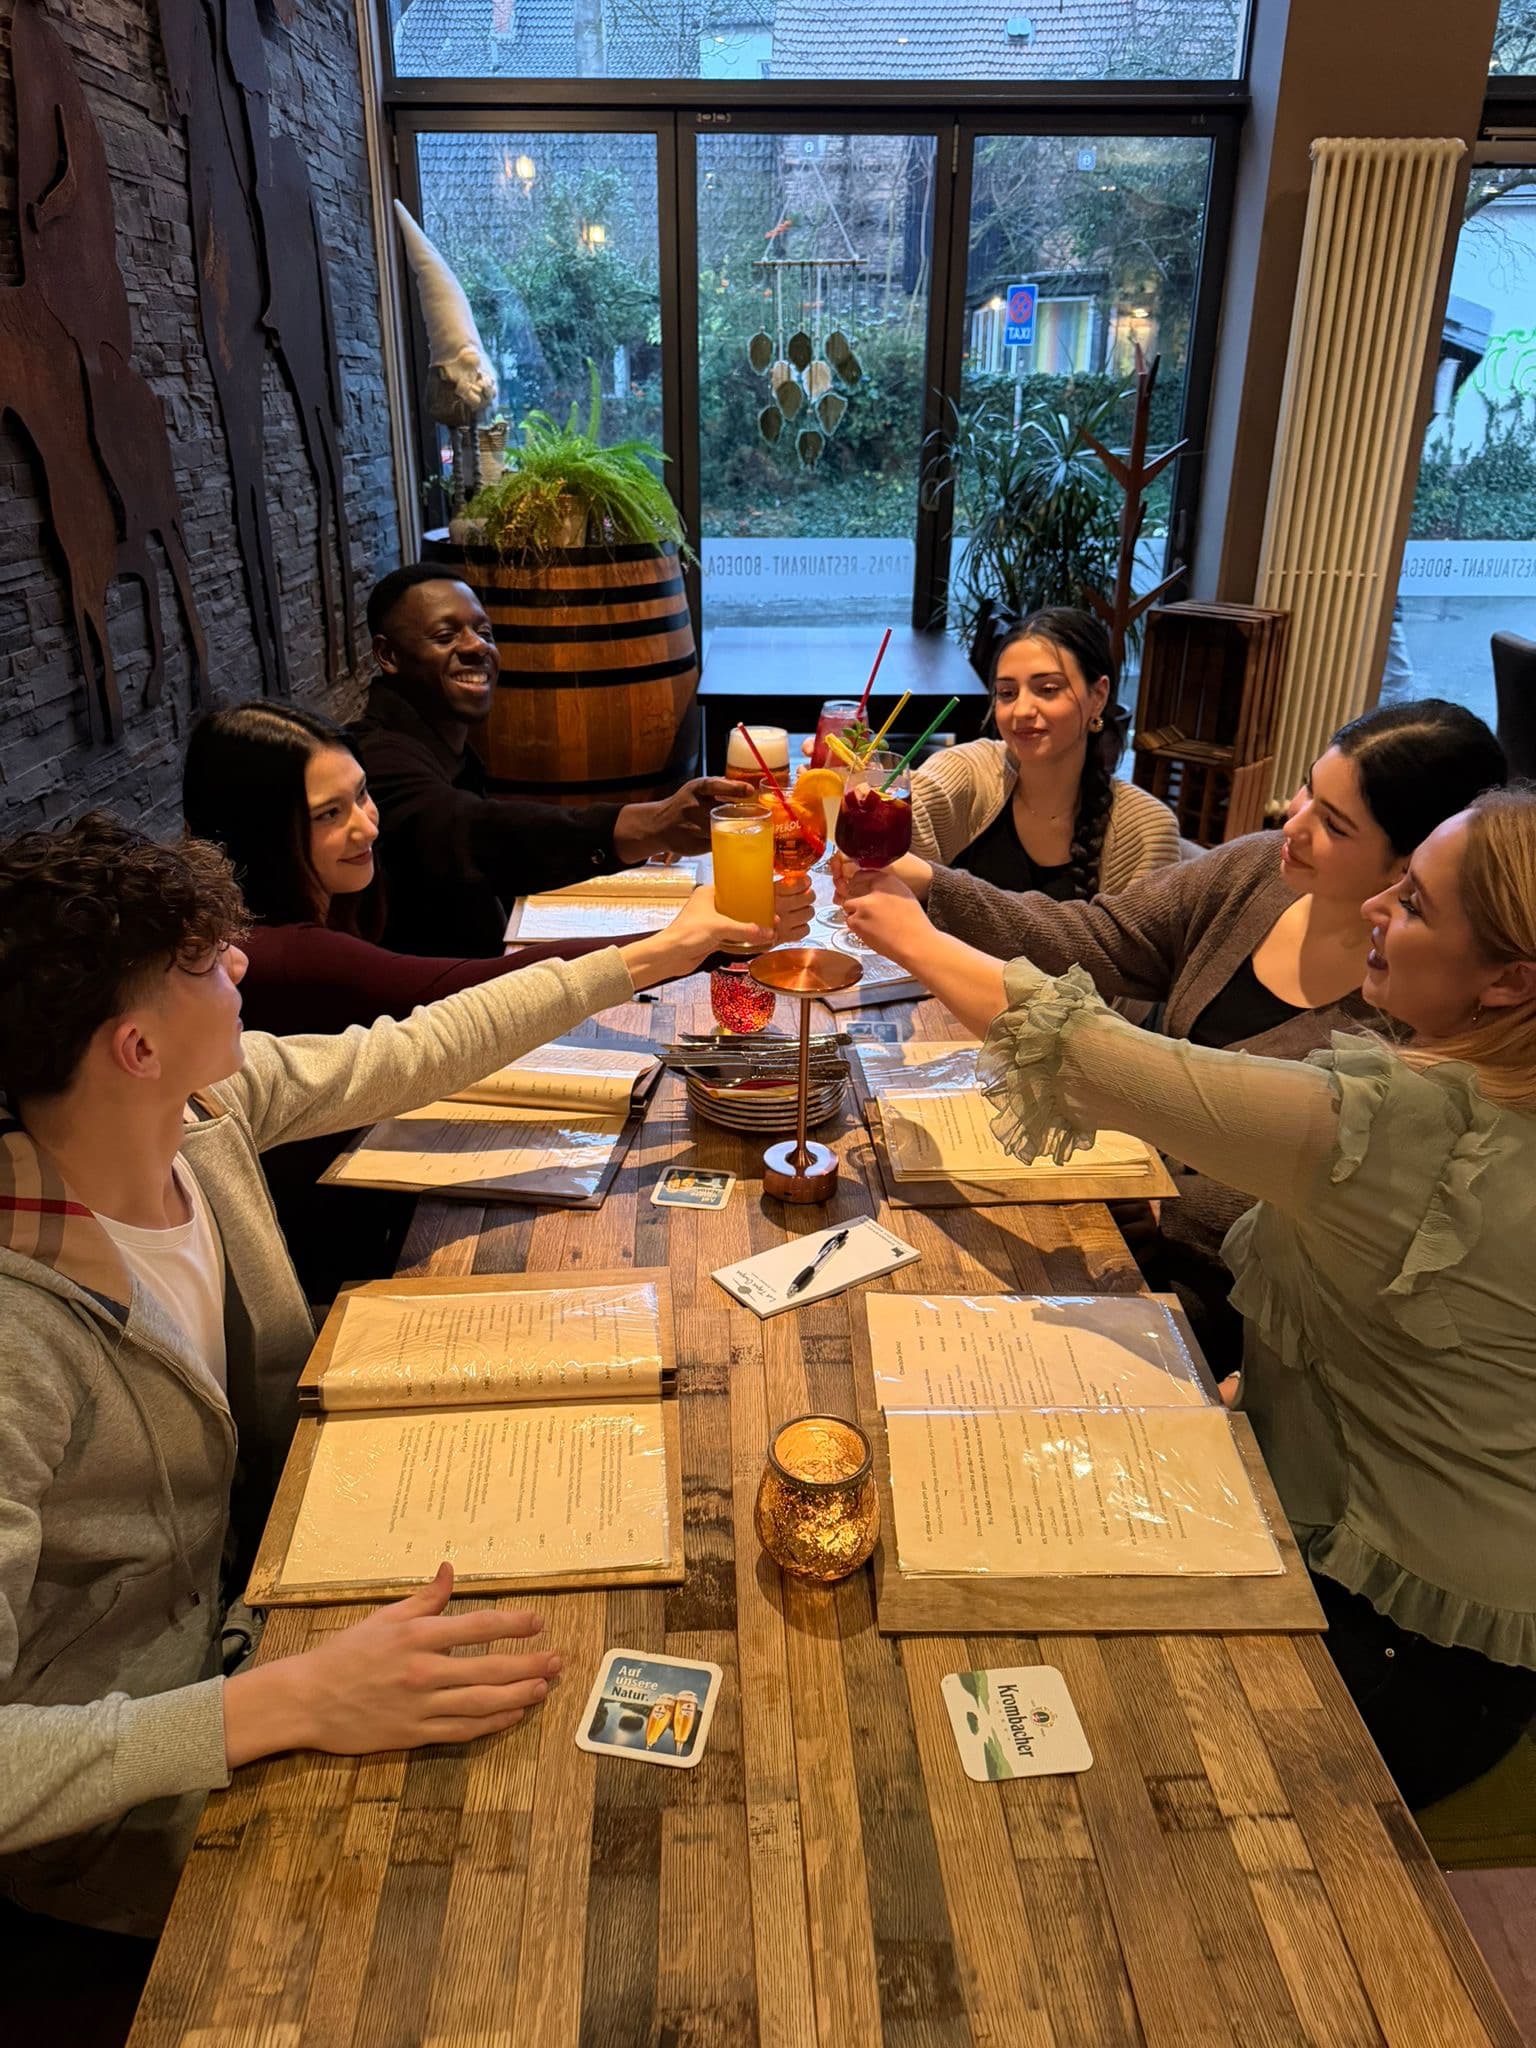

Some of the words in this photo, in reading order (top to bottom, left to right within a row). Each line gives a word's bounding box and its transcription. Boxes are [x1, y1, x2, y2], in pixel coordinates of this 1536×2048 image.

[1008, 327, 1031, 340] TAXI
[775, 820, 801, 833] PEROL
[618, 1665, 643, 1678] Auf
[615, 1676, 659, 1691] unsere
[611, 1686, 649, 1702] Natur.
[997, 1684, 1034, 1758] Krombacher
